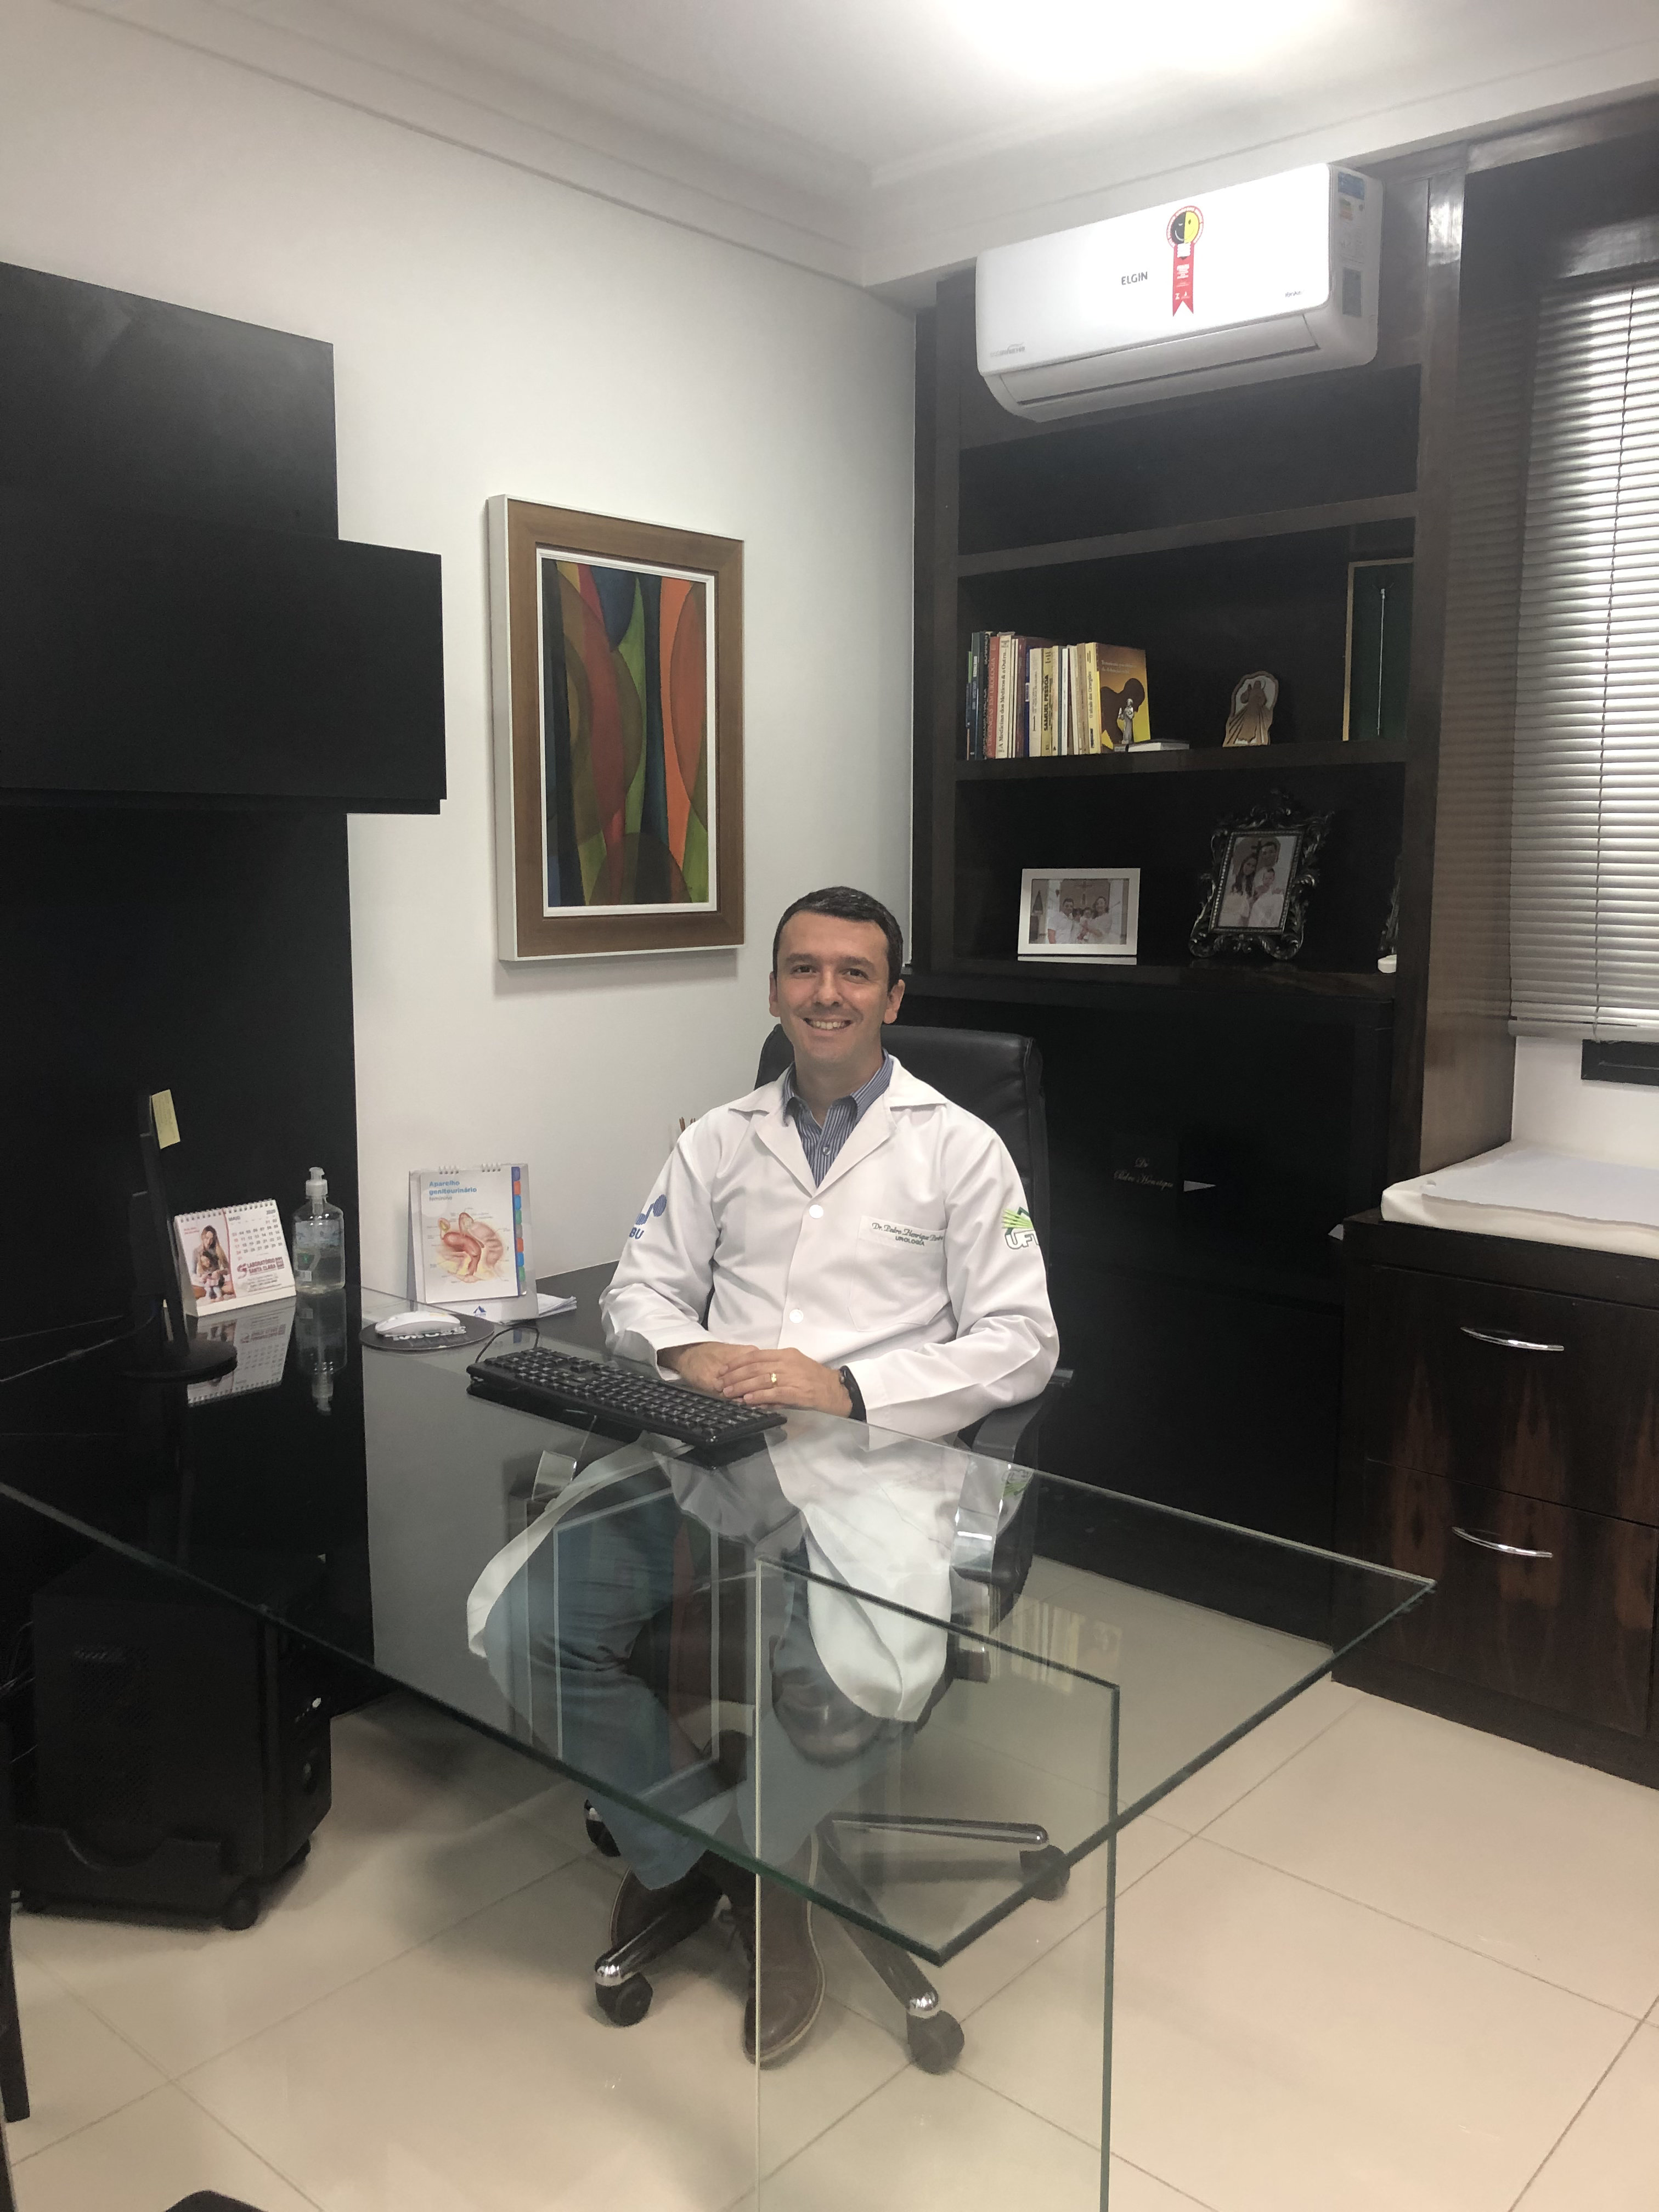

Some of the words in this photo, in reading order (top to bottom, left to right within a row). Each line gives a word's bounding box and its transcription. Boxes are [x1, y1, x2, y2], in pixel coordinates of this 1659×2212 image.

[1121, 271, 1148, 285] ELGIN
[884, 1224, 902, 1234] Pedro
[902, 1228, 929, 1241] Henrique
